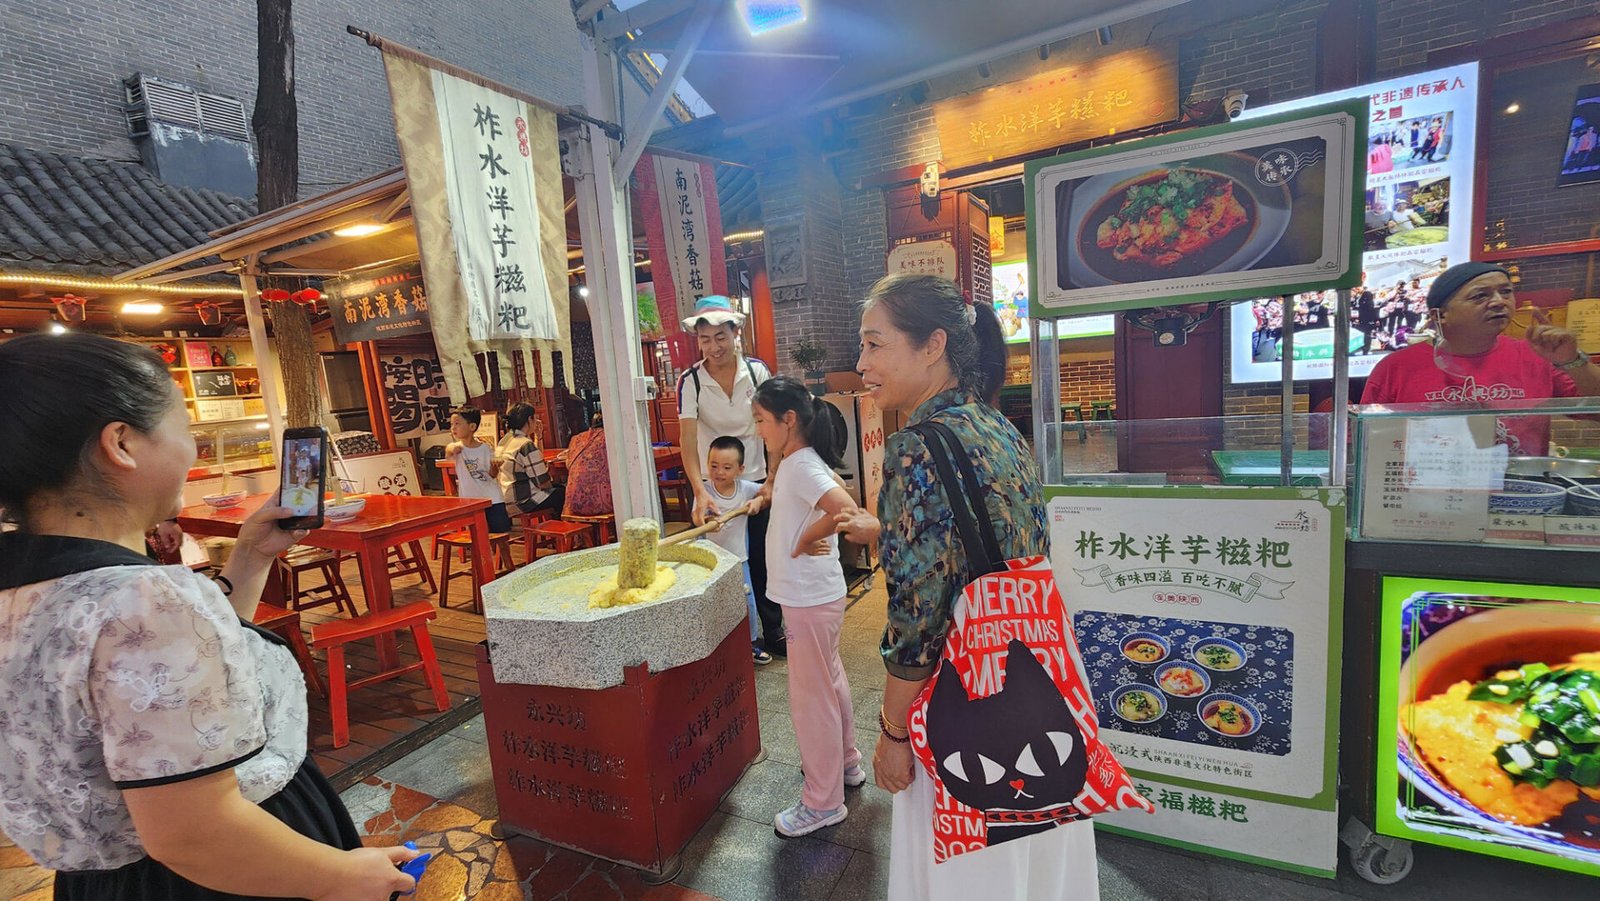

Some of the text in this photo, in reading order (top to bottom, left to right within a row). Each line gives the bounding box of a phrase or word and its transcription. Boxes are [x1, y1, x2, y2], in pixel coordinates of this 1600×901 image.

[473, 102, 531, 332] 柞水洋芋糍粑
[344, 285, 428, 323] 南泥湾香菇
[1074, 530, 1293, 568] 柞水洋芋糍粑
[963, 576, 1054, 619] MERRY
[1114, 569, 1245, 597] 香味四溢 百吃不腻
[966, 619, 1059, 649] CHRISTMAS
[527, 698, 587, 731] 永兴坊
[1153, 756, 1253, 778] 陕西非遗文化特色街区
